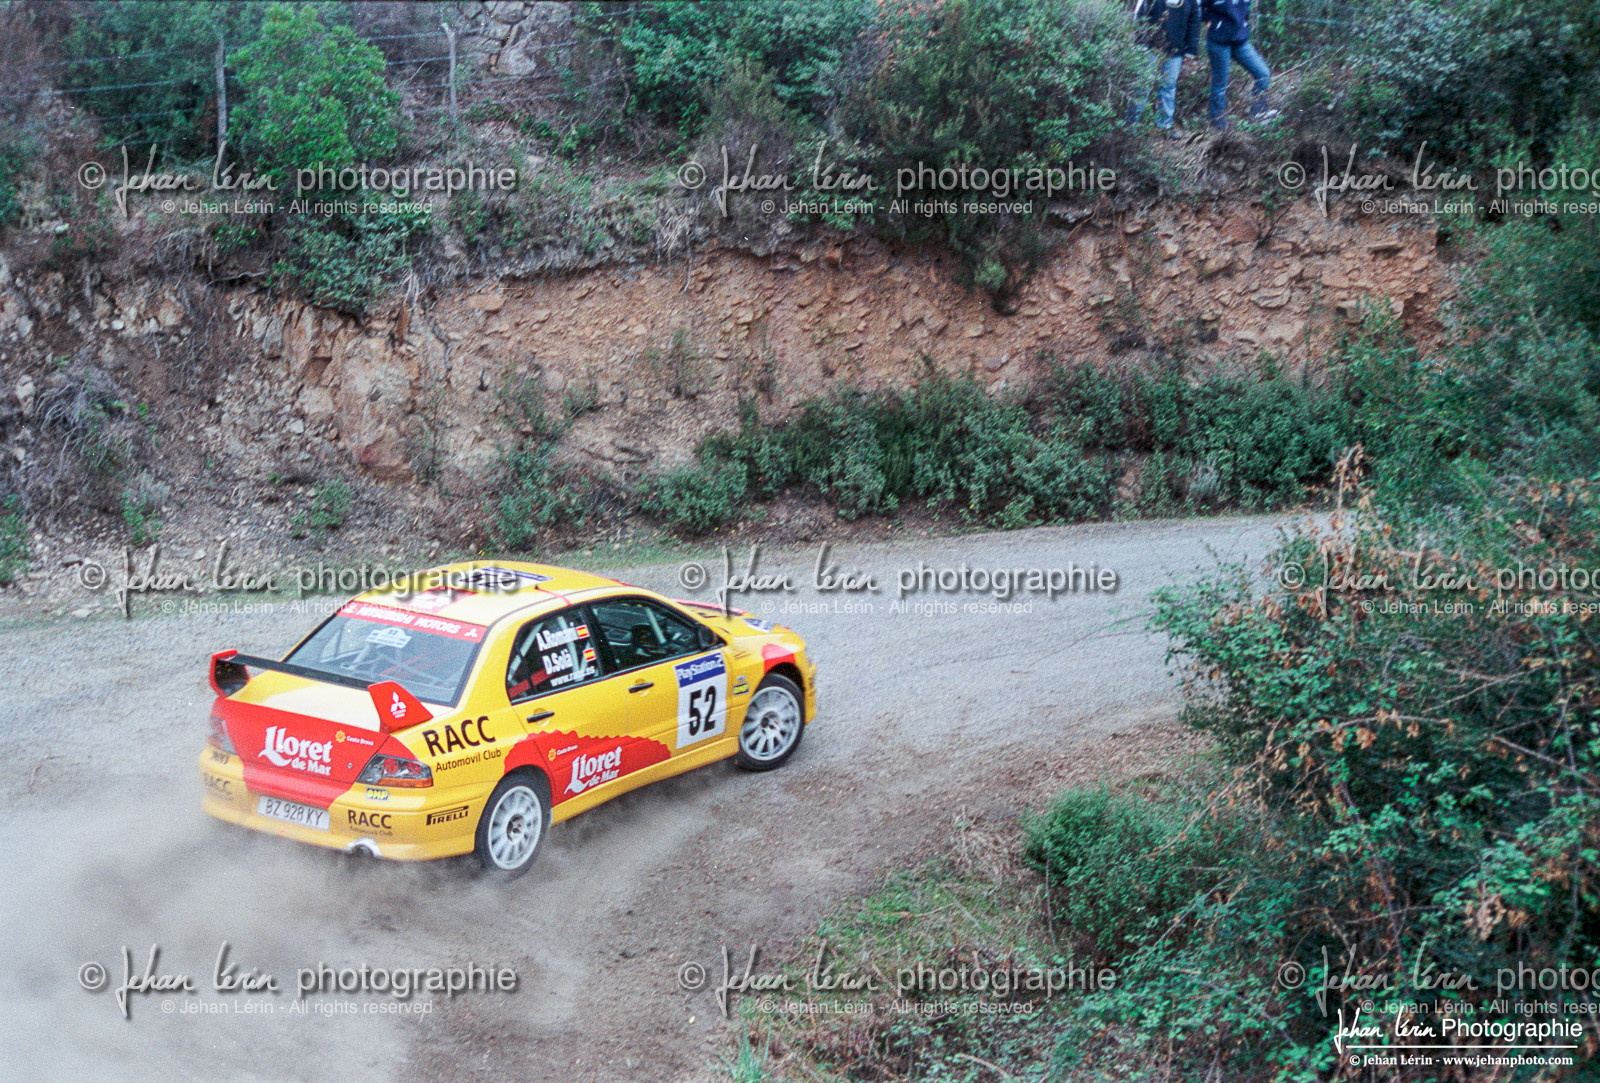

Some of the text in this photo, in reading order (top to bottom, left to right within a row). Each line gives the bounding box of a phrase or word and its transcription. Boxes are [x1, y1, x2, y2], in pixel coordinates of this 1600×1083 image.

[413, 616, 461, 635] MOTORS
[689, 685, 716, 736] 52
[258, 725, 333, 767] Lloret
[422, 716, 497, 757] RACC
[291, 756, 331, 776] de Mar
[435, 749, 502, 773] Automóvil Club
[564, 746, 622, 795] Lloret
[588, 769, 620, 788] de Mar
[265, 799, 324, 826] BZ 928 KY
[347, 809, 392, 829] RACC
[426, 805, 469, 826] PIRELLI
